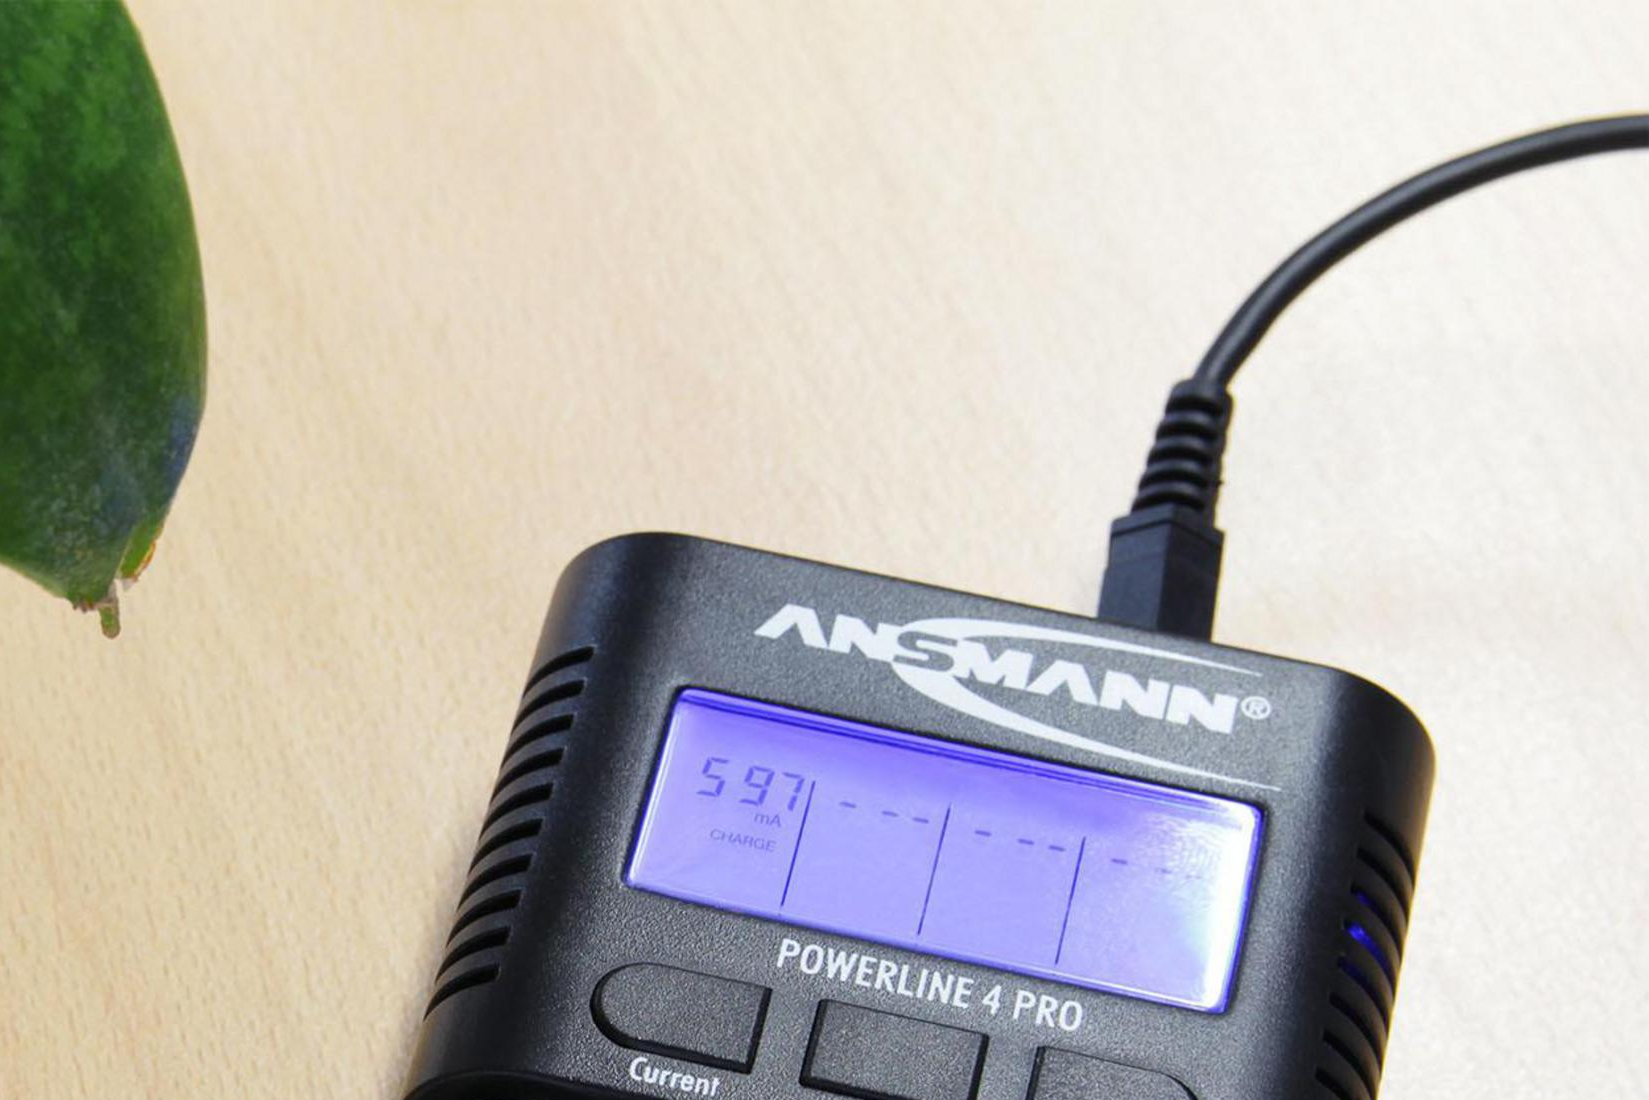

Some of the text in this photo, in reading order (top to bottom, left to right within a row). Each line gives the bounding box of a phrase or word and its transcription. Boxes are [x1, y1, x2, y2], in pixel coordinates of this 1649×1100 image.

[754, 813, 781, 828] mA
[710, 828, 776, 852] CHARGE
[776, 938, 1083, 1031] POWERLINE 4 PRO
[629, 1056, 720, 1097] Current
